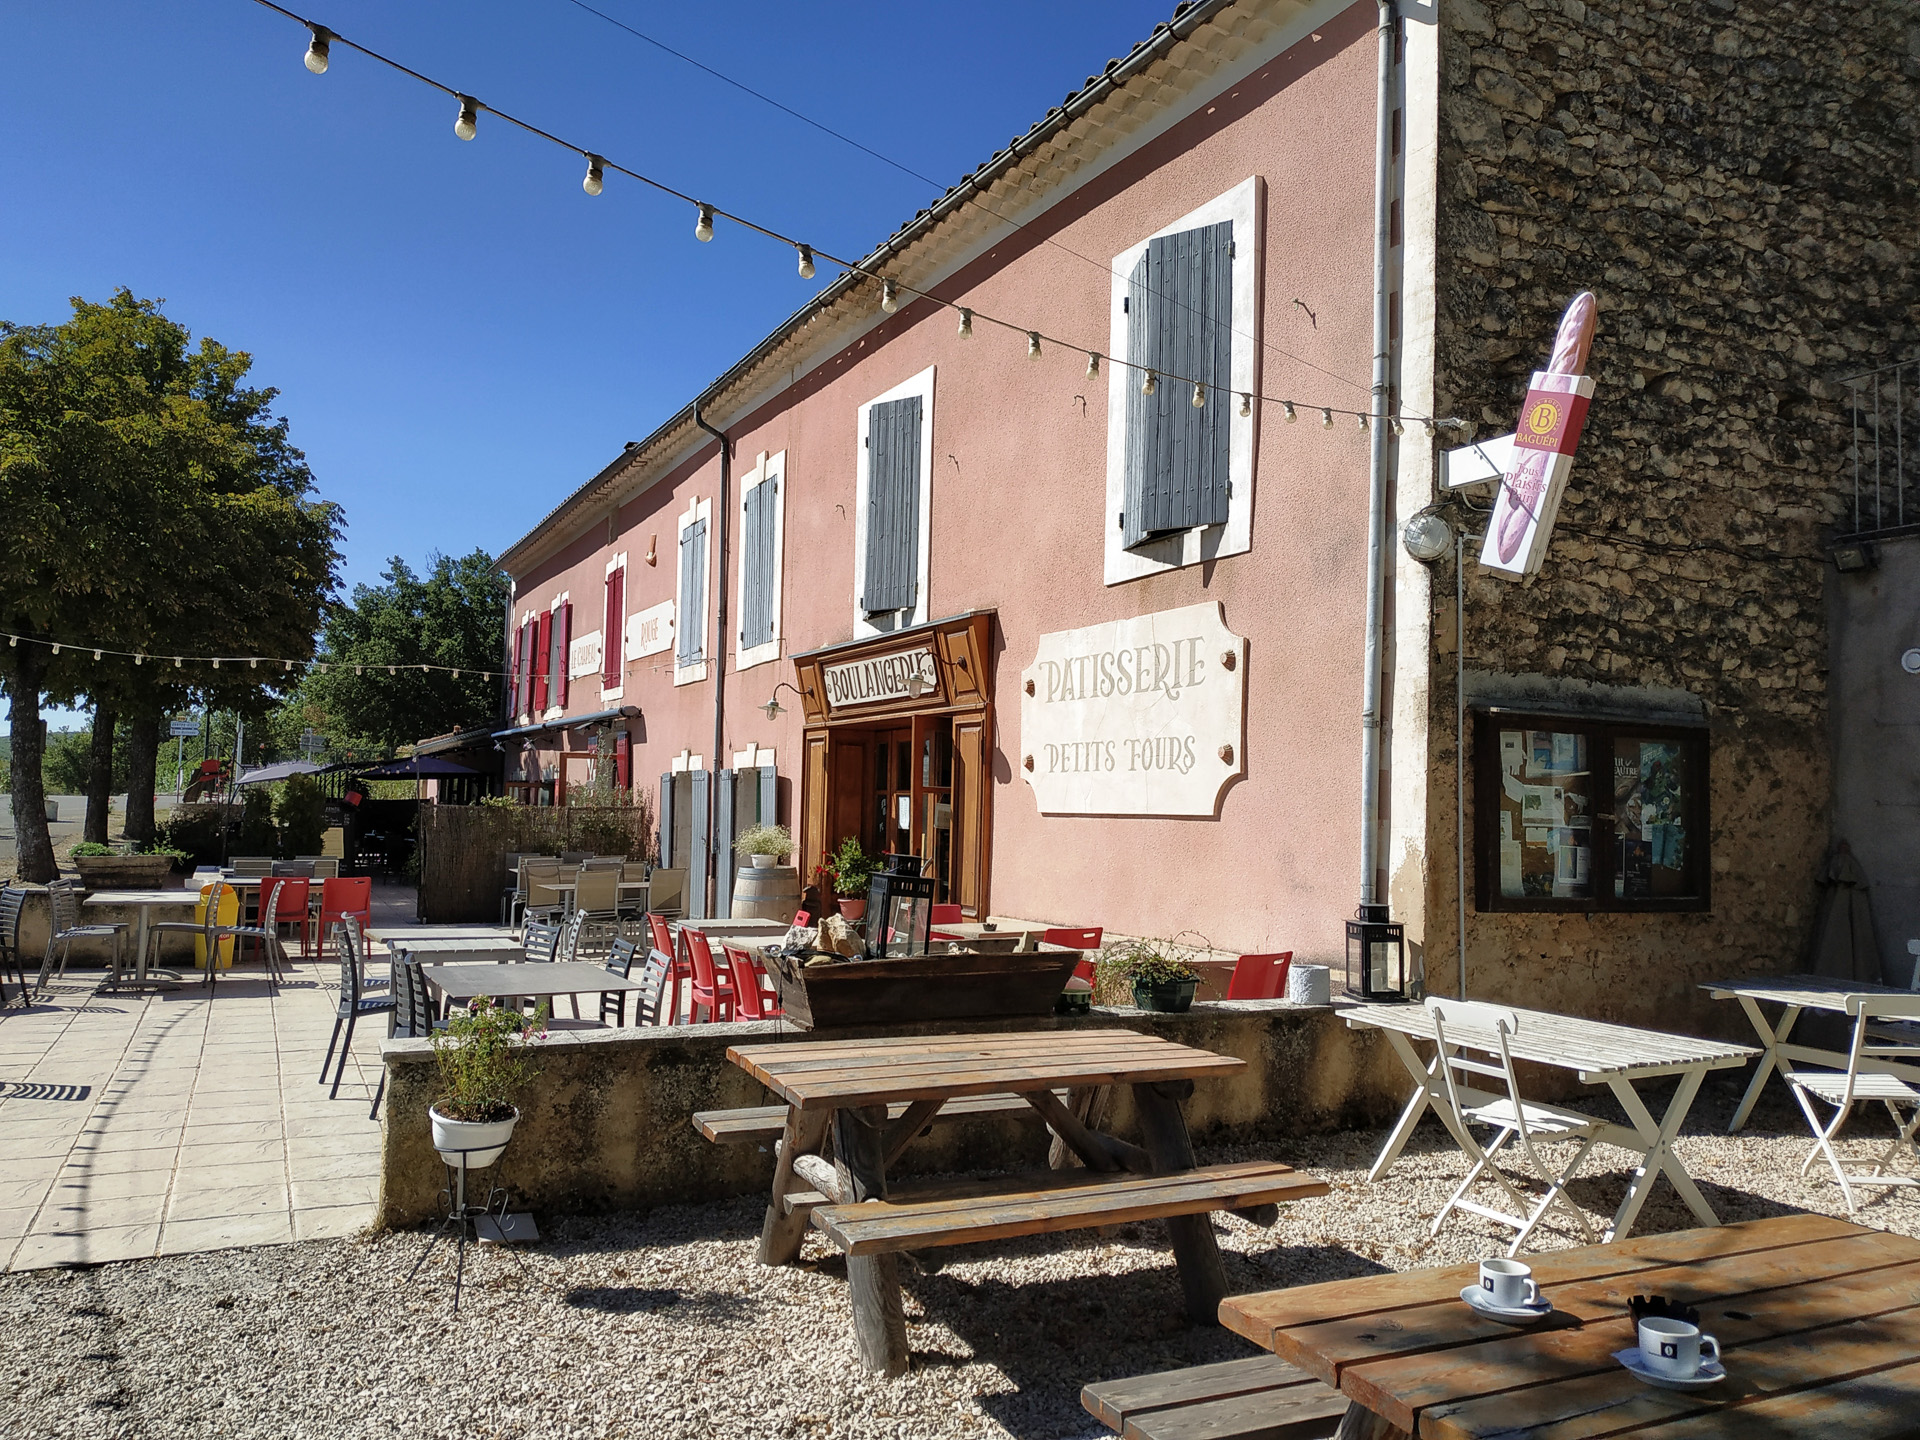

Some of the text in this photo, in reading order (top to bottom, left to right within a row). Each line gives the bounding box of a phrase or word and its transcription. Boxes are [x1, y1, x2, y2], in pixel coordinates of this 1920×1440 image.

[1516, 433, 1559, 448] BAGUÉPI
[1517, 462, 1540, 477] Tous
[1505, 472, 1547, 492] Plaisirs
[1039, 636, 1206, 703] PATISSERIE
[1044, 735, 1196, 775] PETITS FOURS
